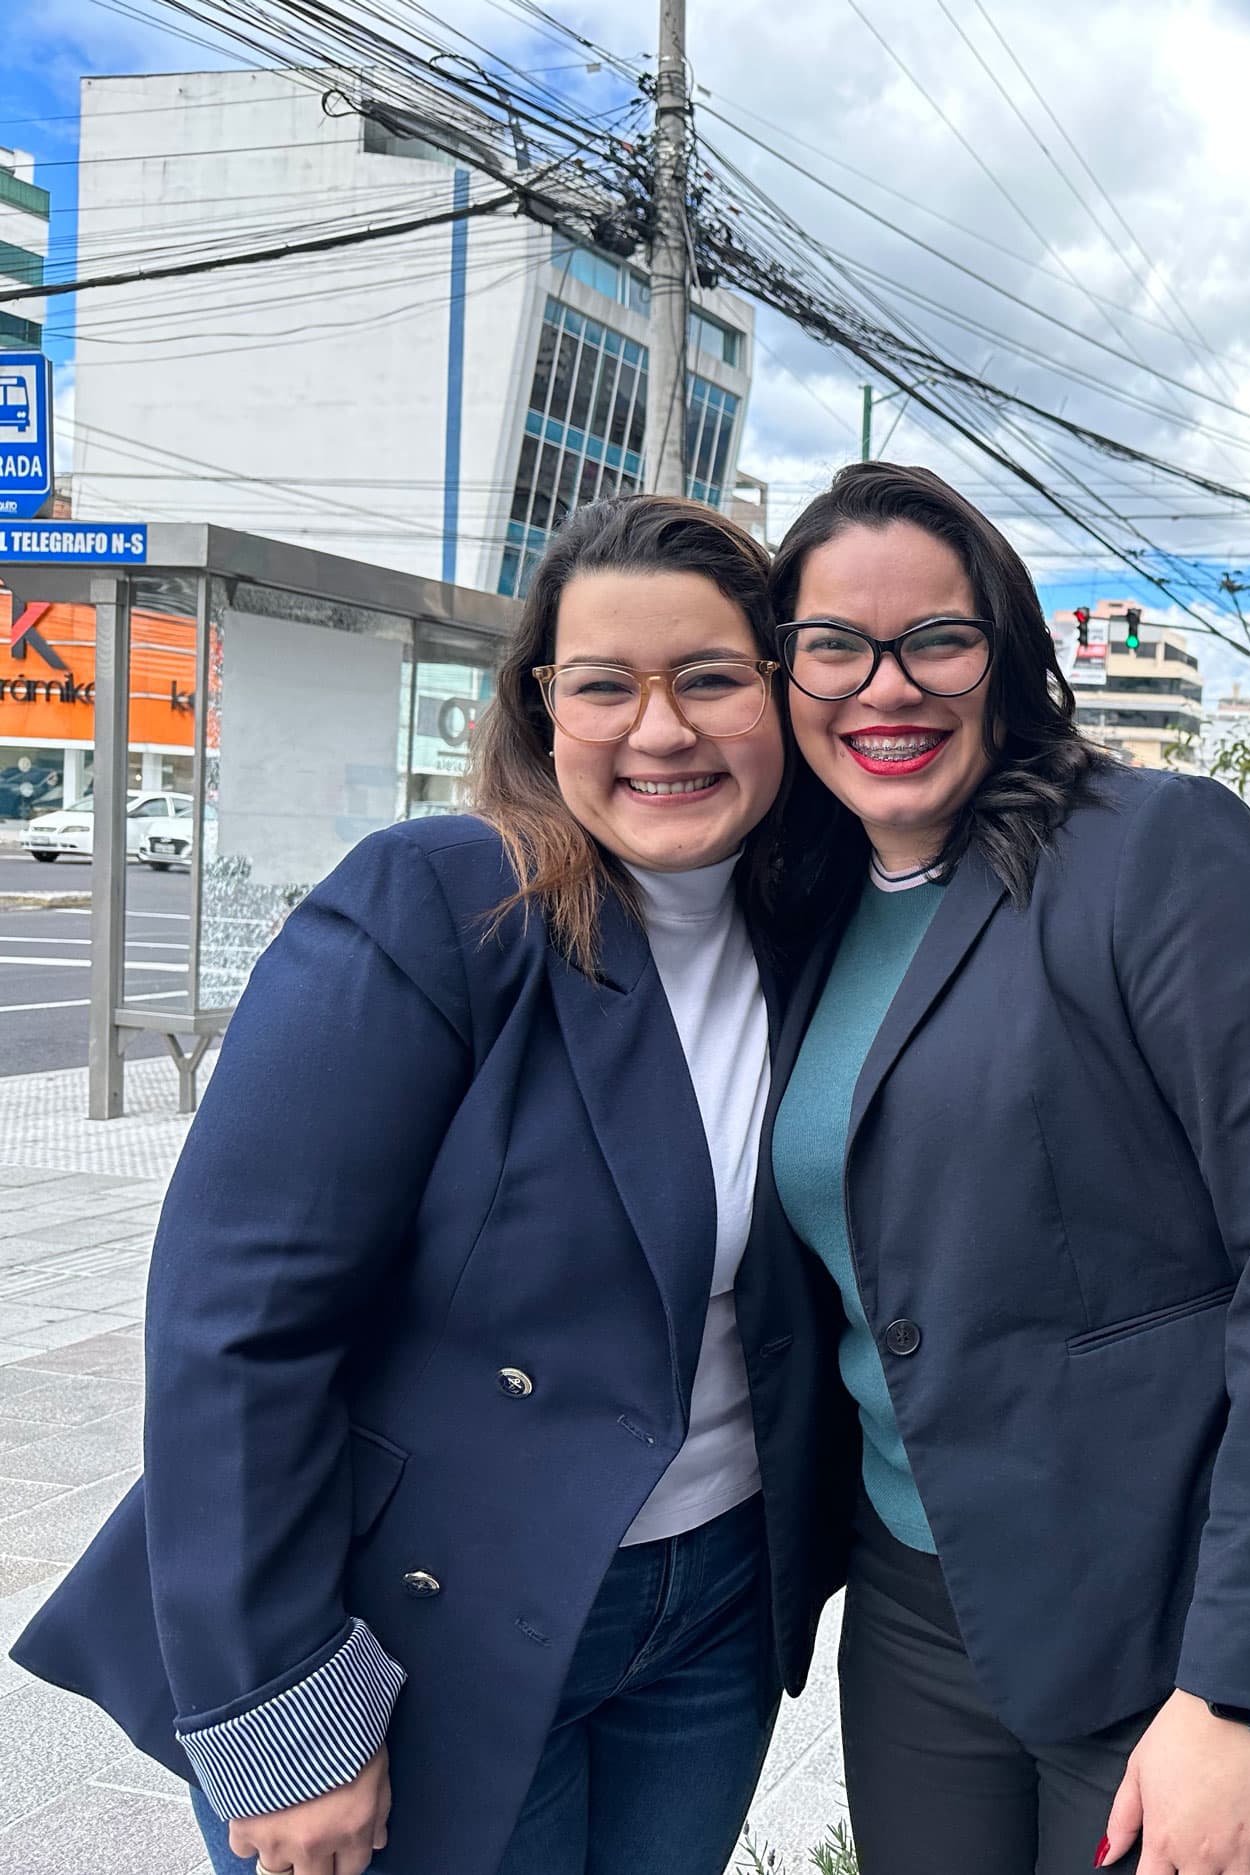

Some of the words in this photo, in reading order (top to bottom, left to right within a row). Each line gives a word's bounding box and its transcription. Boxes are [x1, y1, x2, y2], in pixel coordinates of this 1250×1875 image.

[0, 455, 43, 478] ADA
[11, 531, 108, 554] TELEGRAFO
[111, 532, 144, 555] N-S
